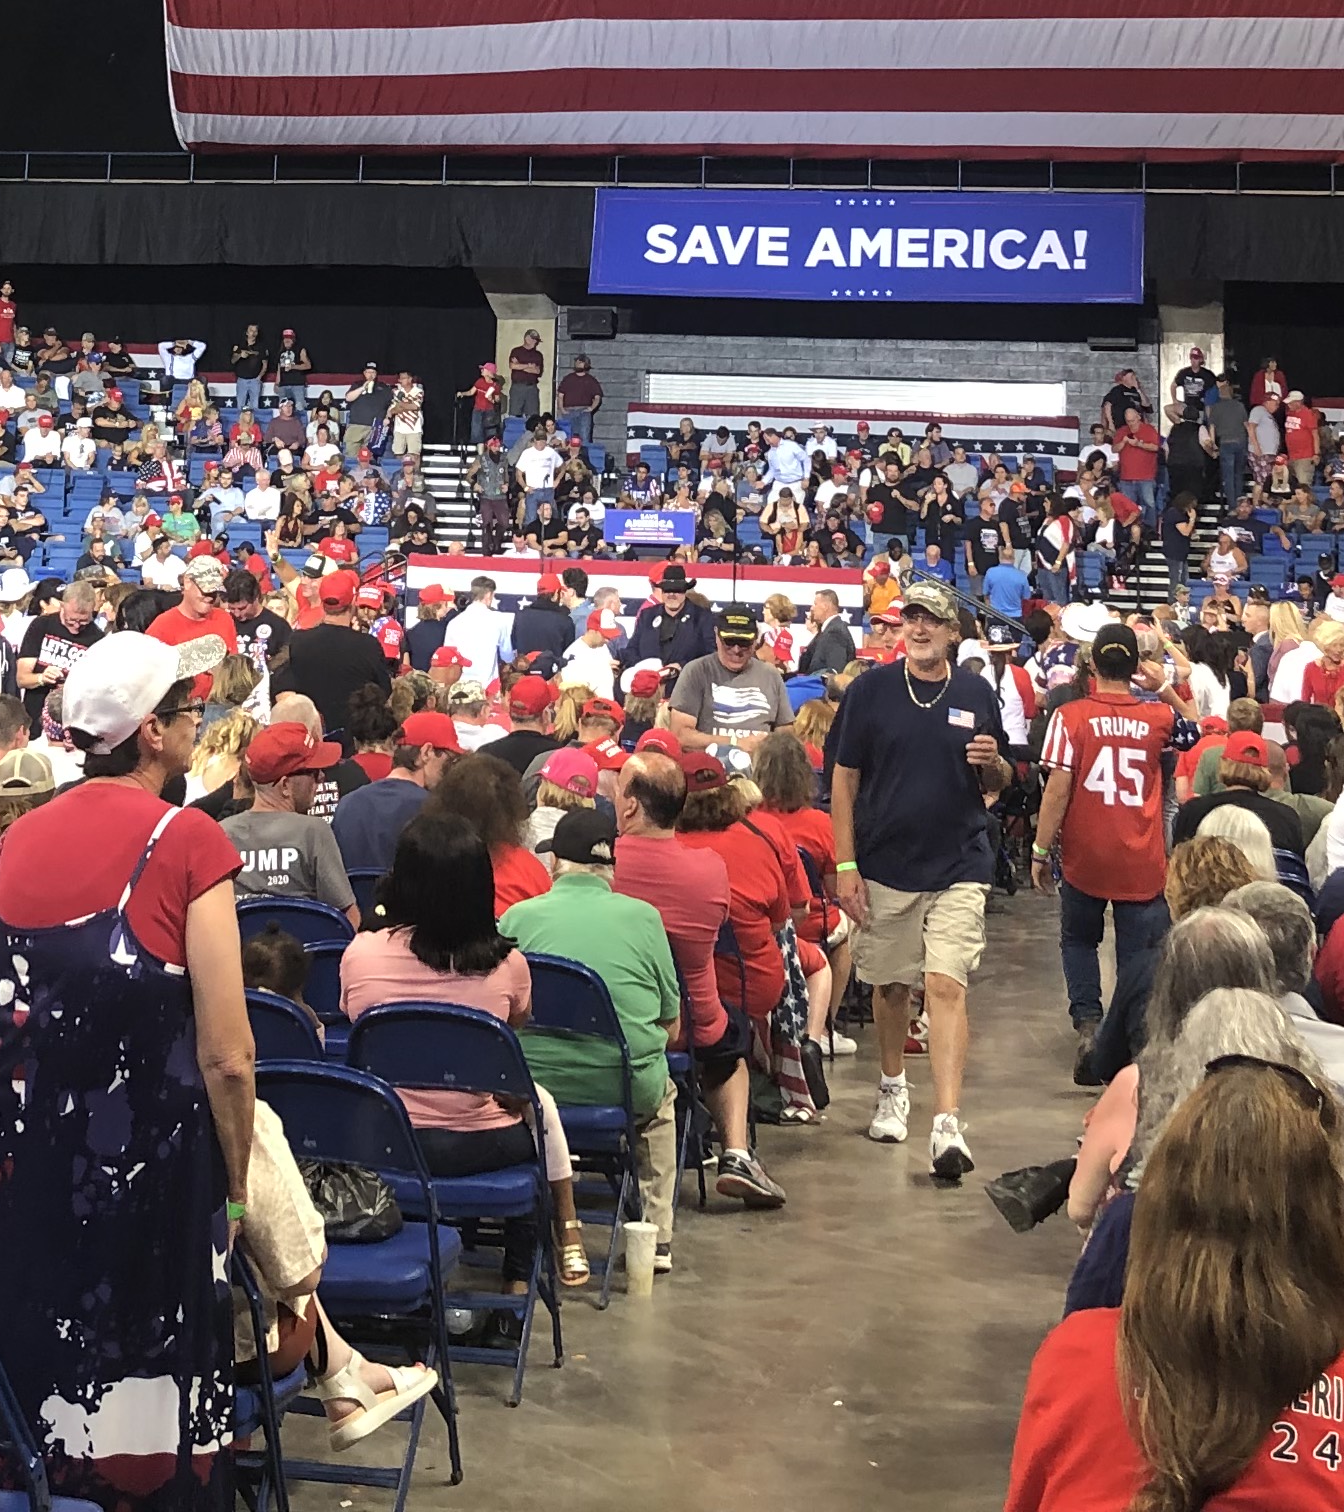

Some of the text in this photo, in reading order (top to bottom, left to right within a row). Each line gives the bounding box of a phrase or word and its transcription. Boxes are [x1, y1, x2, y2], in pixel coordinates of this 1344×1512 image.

[643, 223, 1088, 271] SAVE AMERICA!
[1088, 716, 1150, 740] TRUMP
[1083, 746, 1147, 807] 45
[239, 848, 299, 873] UMP
[267, 874, 290, 886] 2020
